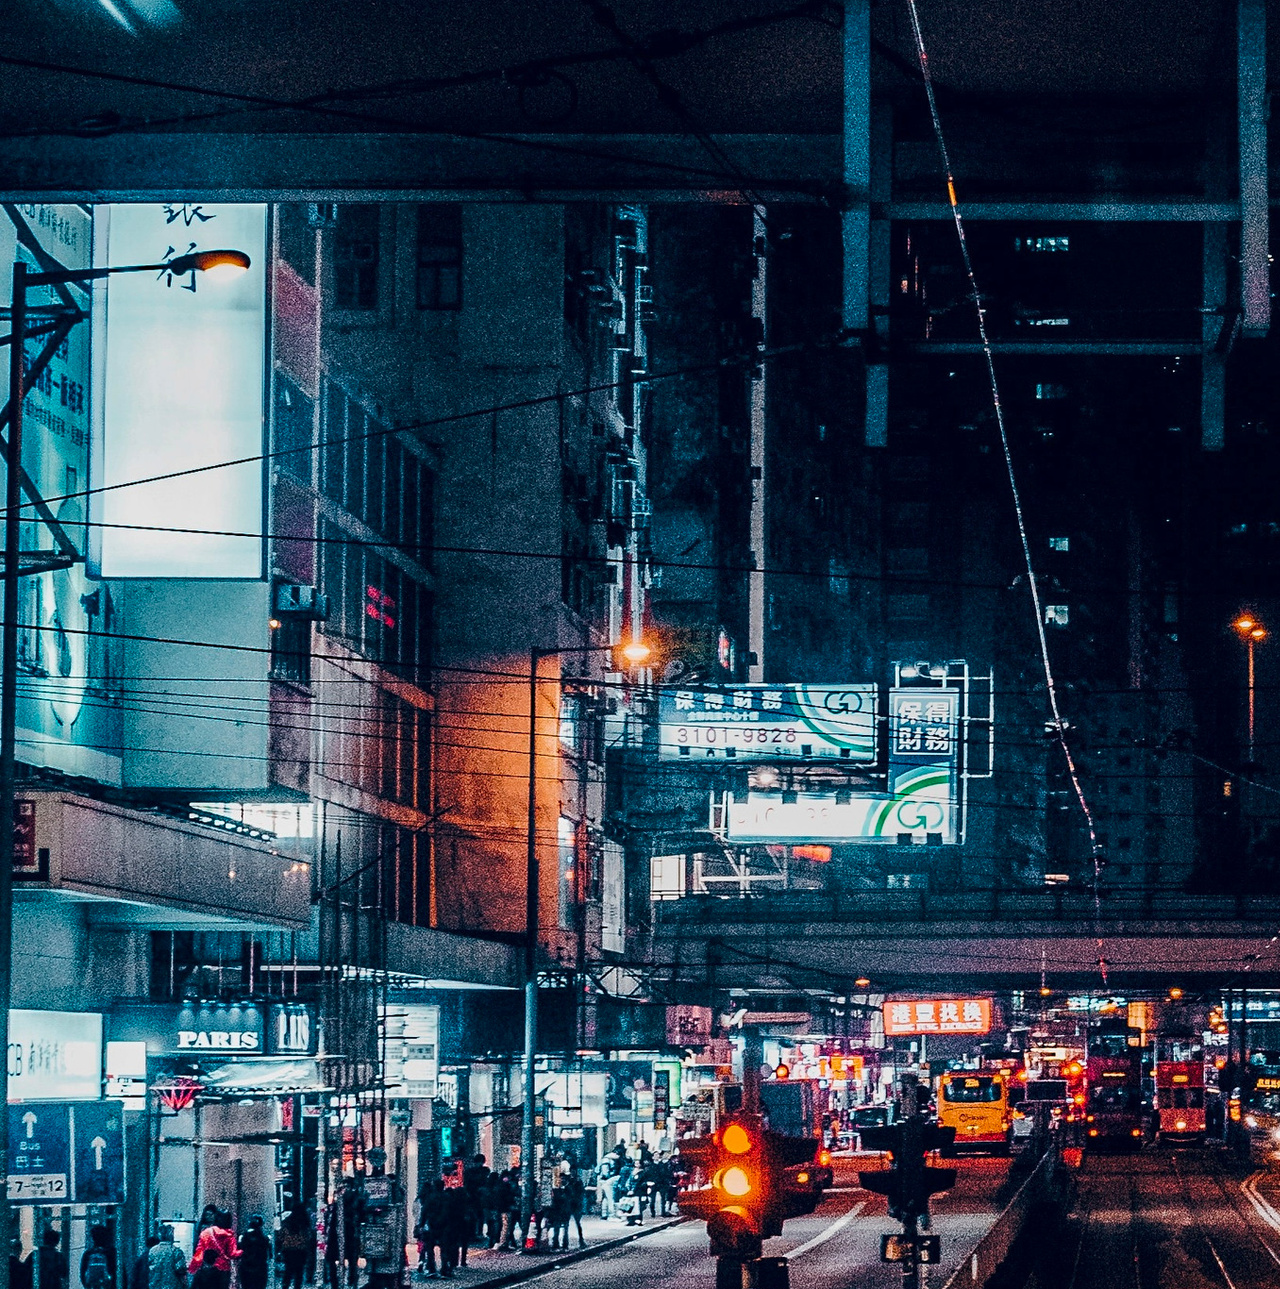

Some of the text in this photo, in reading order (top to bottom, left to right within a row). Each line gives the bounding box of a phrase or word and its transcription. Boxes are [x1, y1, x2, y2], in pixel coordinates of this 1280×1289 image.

[674, 690, 783, 711] 保得財務
[898, 701, 950, 724] 保得
[677, 727, 797, 743] 3101-9828
[898, 727, 950, 751] 財務
[177, 1031, 259, 1049] PARIS
[20, 1141, 41, 1151] Bus
[15, 1156, 45, 1169] 巴士
